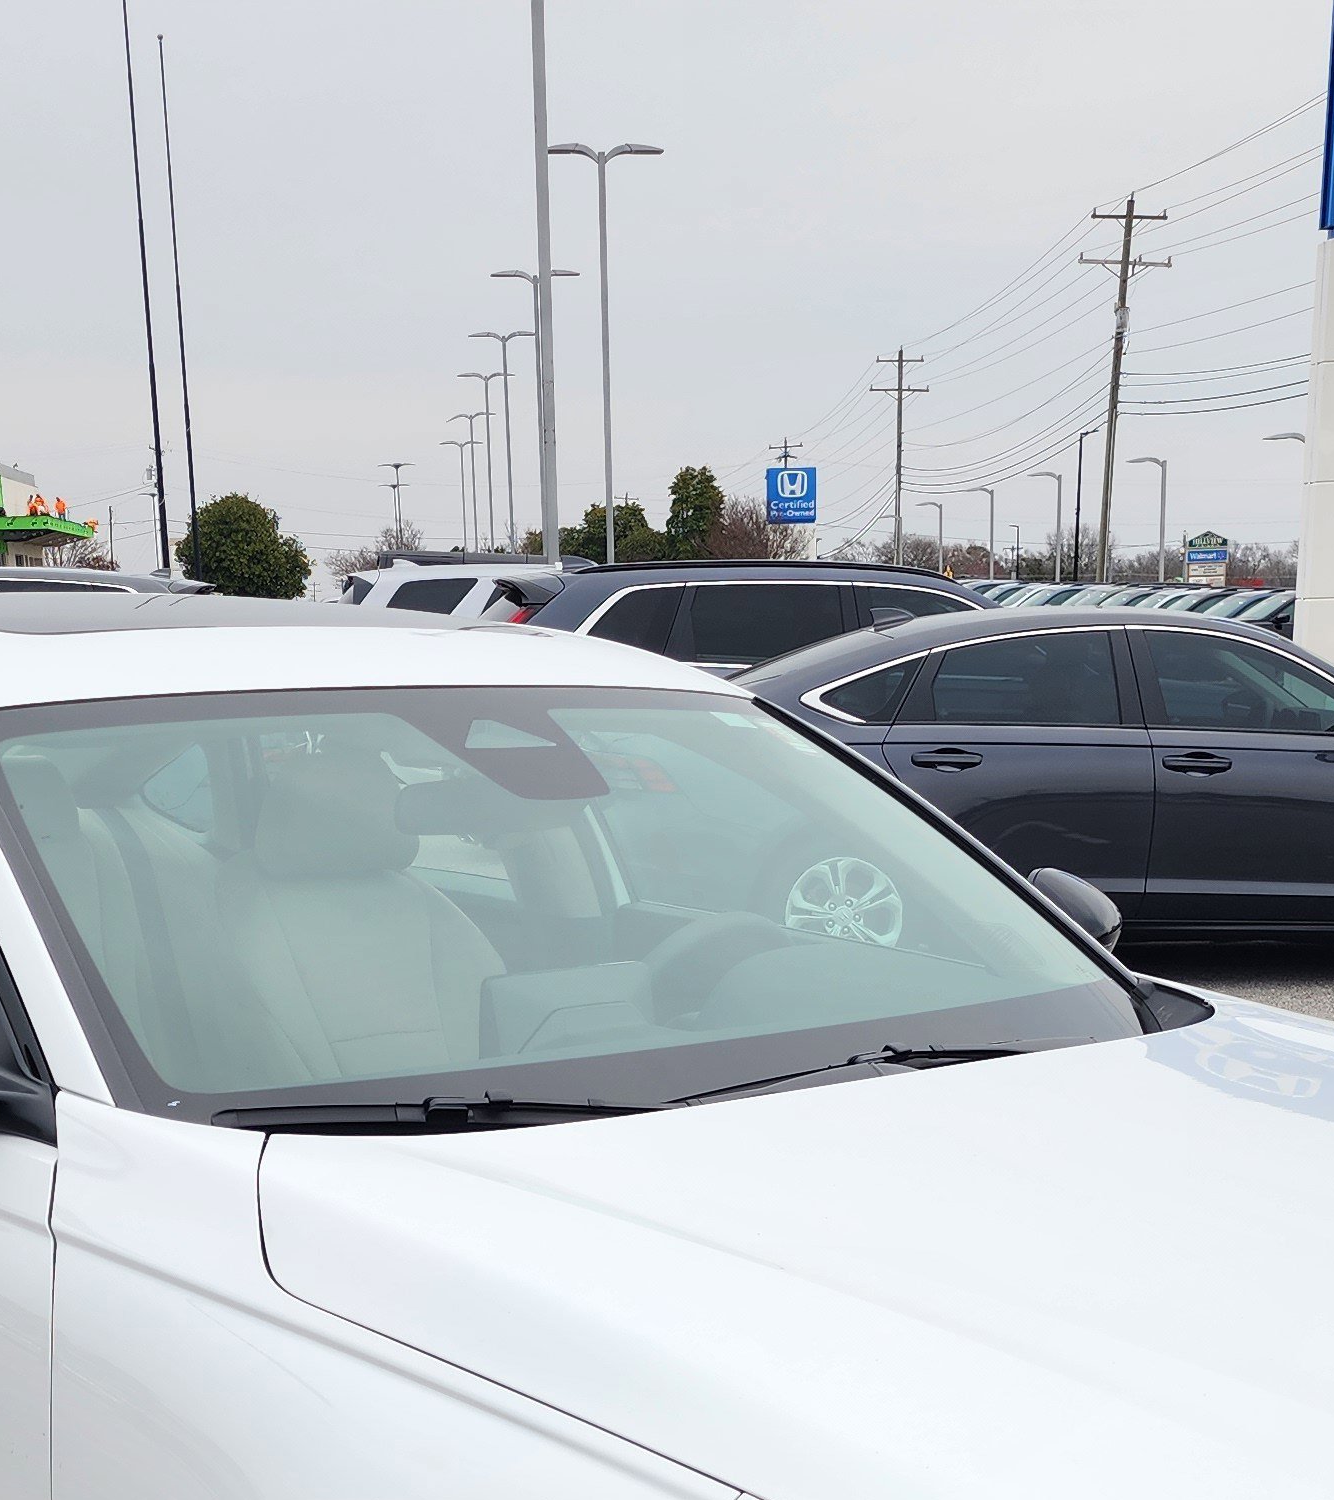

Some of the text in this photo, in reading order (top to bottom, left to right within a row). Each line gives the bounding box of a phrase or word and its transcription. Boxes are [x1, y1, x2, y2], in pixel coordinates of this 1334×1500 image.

[770, 500, 815, 509] Certified
[770, 509, 815, 517] Pre-Owned
[1189, 552, 1217, 560] Walmart
